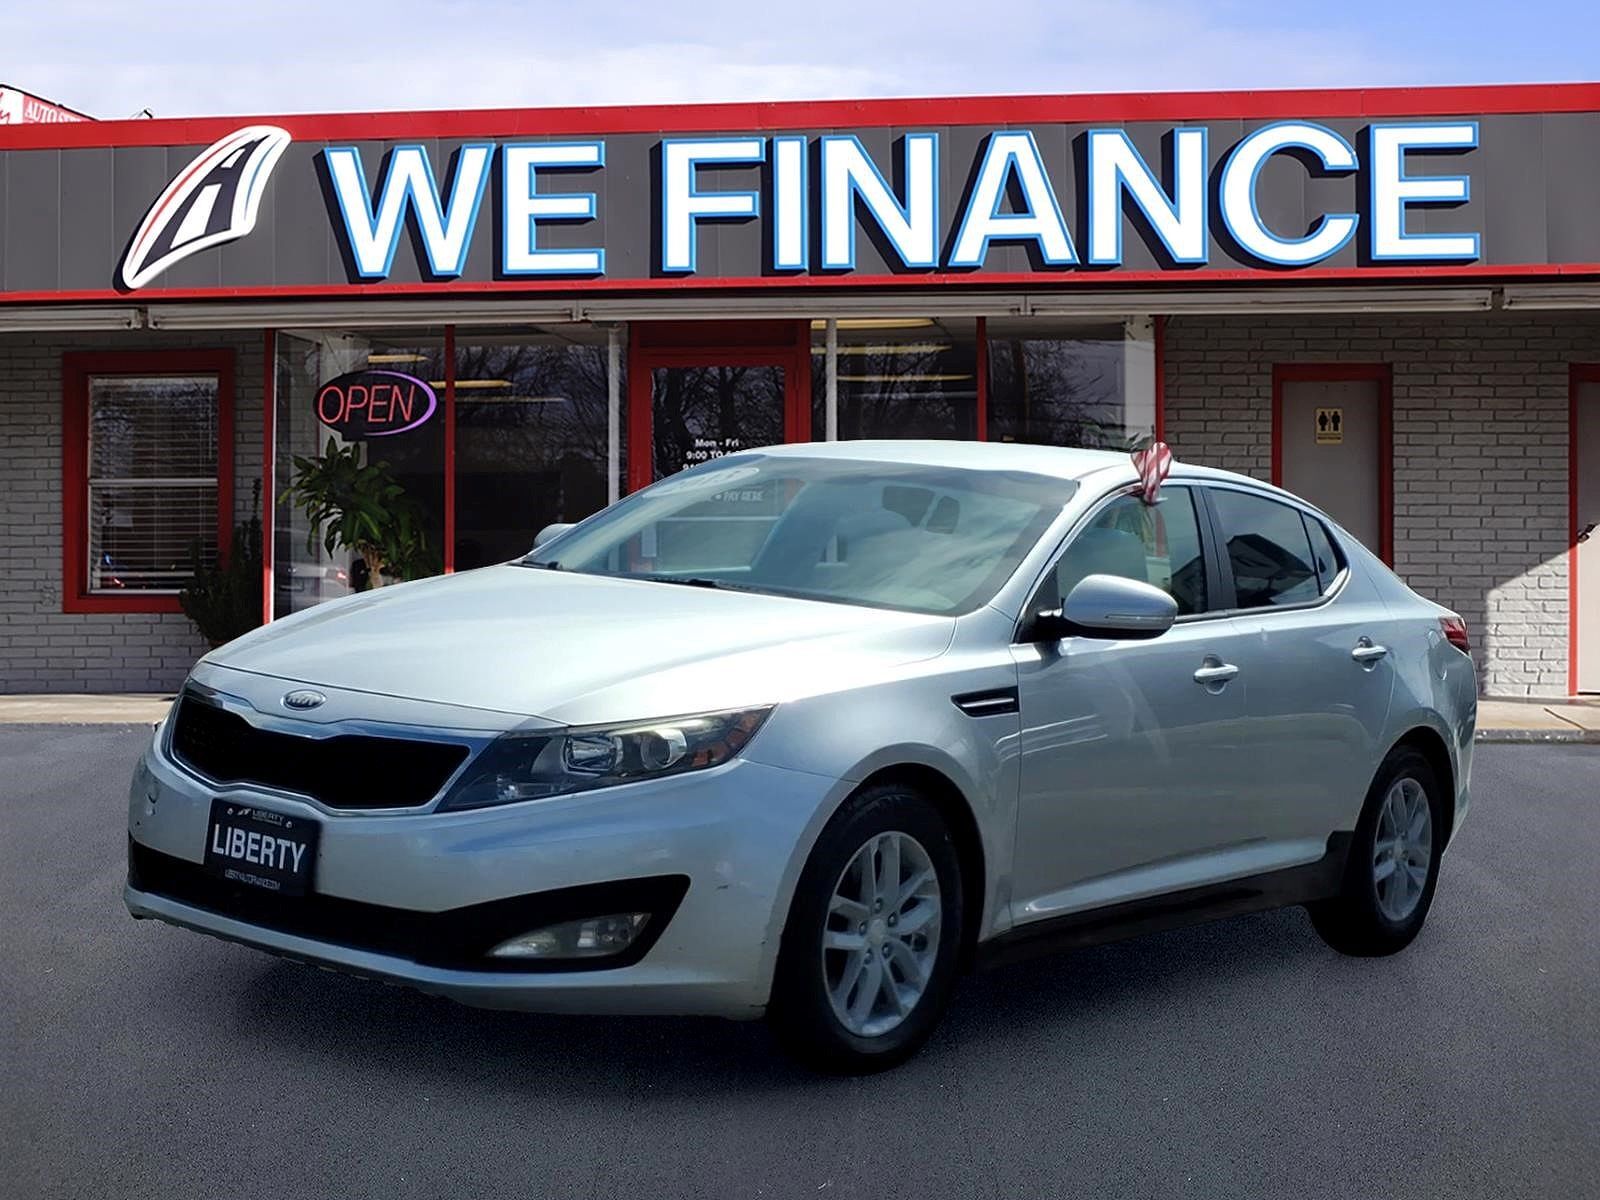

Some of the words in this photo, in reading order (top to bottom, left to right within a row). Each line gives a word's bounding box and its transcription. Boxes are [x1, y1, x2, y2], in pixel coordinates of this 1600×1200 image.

[25, 100, 57, 123] AUTO
[324, 141, 605, 278] WE
[662, 120, 1481, 274] FINANCE
[318, 384, 415, 423] OPEN
[686, 451, 707, 459] 9:00
[695, 438, 717, 447] Mon
[725, 438, 740, 447] Fri
[212, 823, 307, 873] LIBERTY
